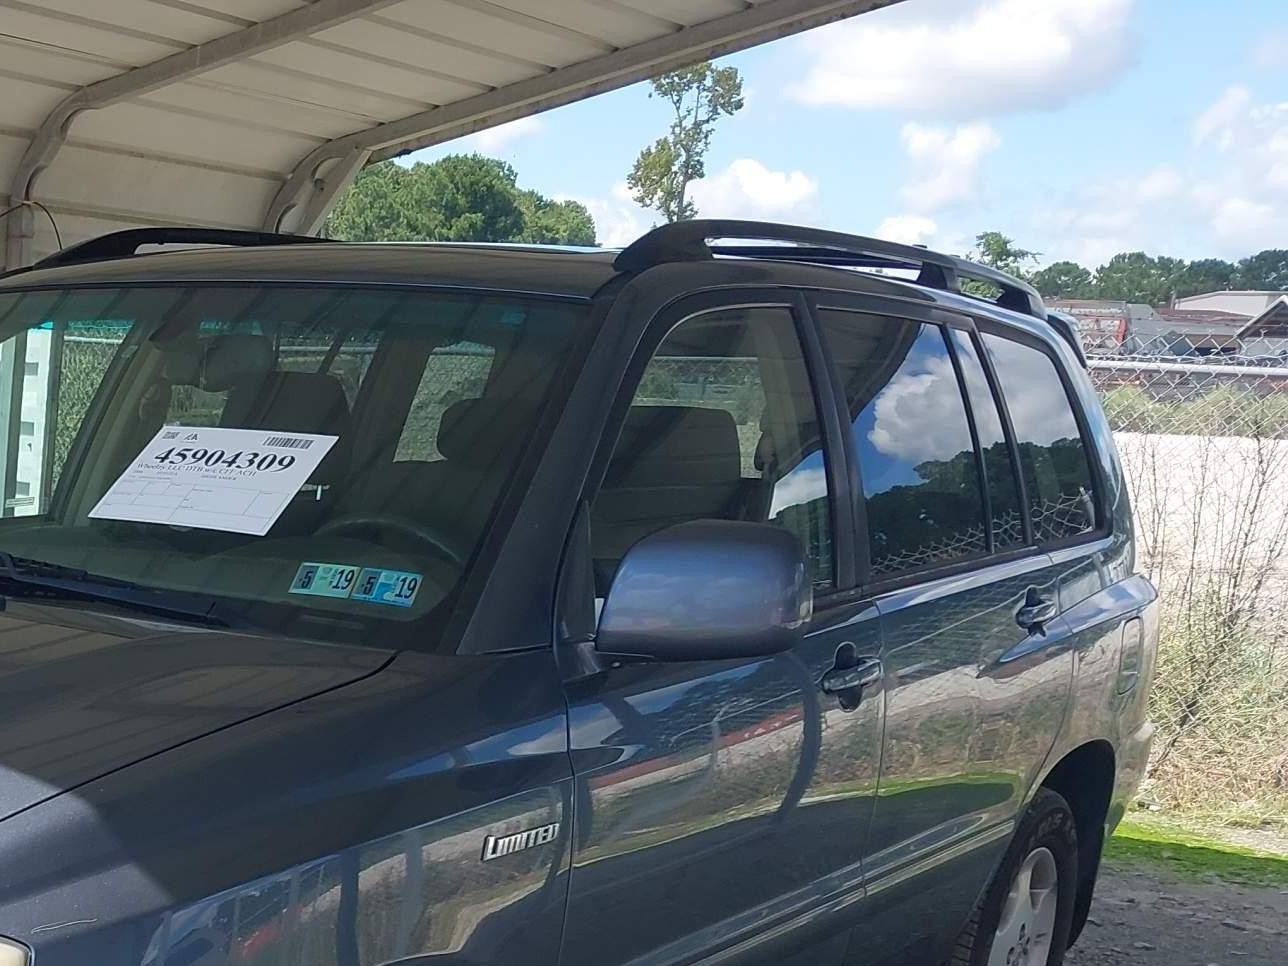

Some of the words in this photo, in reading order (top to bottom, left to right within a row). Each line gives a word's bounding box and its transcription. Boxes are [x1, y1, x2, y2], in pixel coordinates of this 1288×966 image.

[154, 447, 296, 473] 45904309
[332, 569, 355, 590] 19
[395, 576, 418, 599] 19
